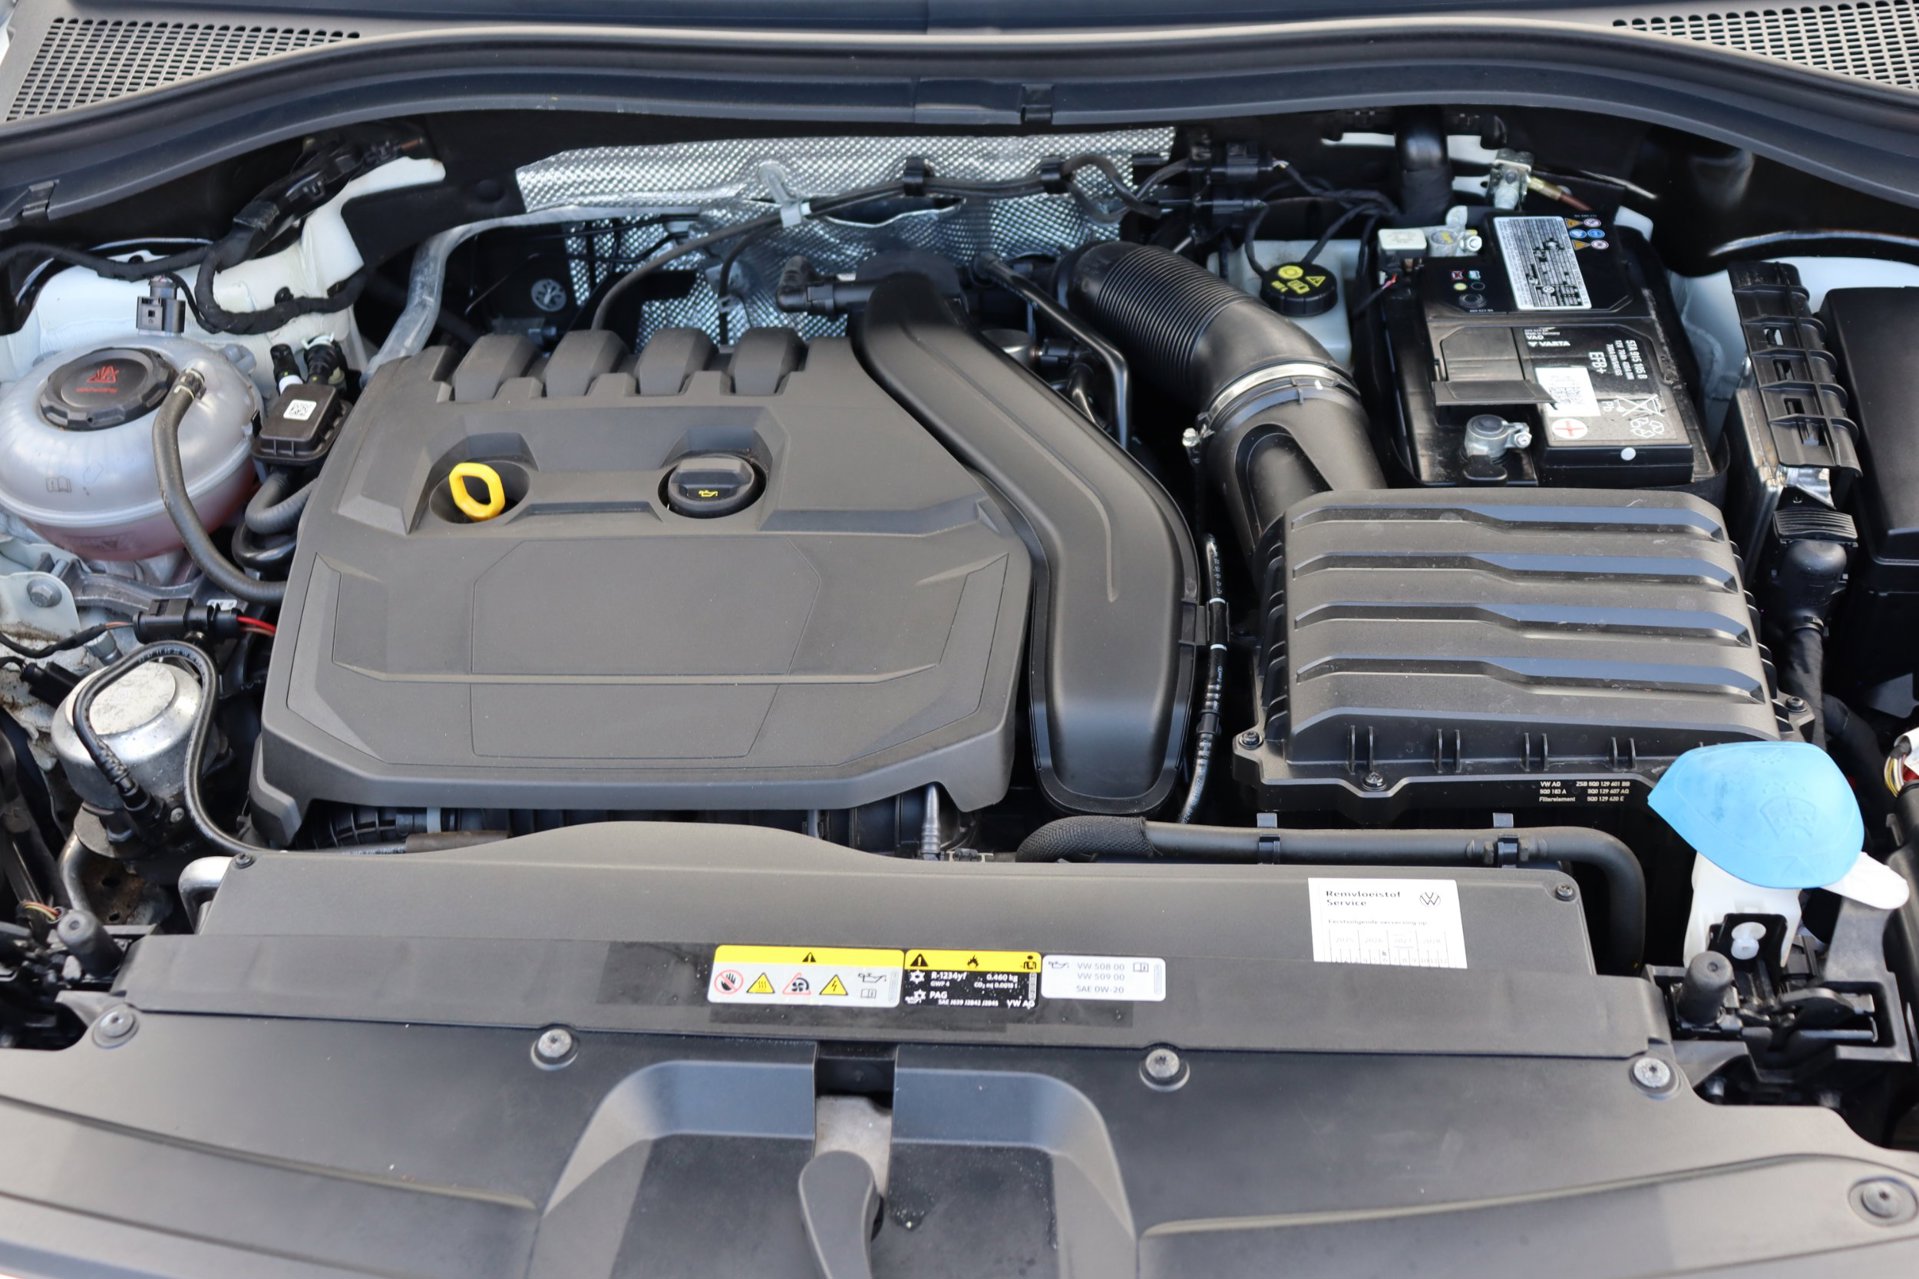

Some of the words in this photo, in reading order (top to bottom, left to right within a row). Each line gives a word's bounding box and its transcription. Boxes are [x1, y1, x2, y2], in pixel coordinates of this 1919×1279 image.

[1588, 351, 1608, 374] EFB+
[931, 972, 967, 980] R-1234yf
[1009, 974, 1018, 982] kg
[930, 991, 948, 999] PAG
